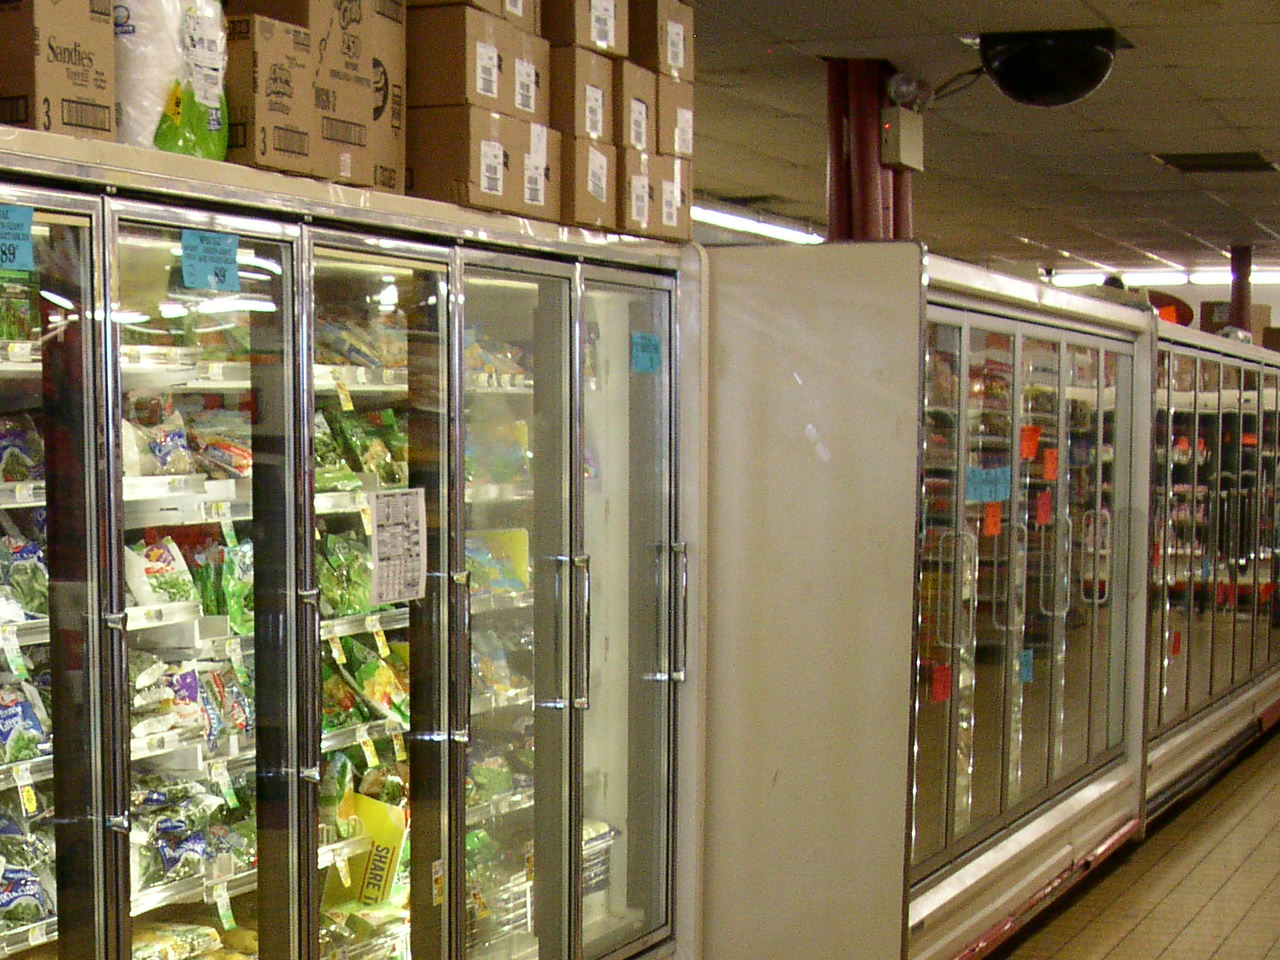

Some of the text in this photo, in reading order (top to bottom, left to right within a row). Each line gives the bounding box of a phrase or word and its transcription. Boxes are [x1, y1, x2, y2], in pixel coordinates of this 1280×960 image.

[47, 34, 95, 68] Sandies
[43, 97, 51, 131] 3
[366, 845, 390, 892] SHARE
